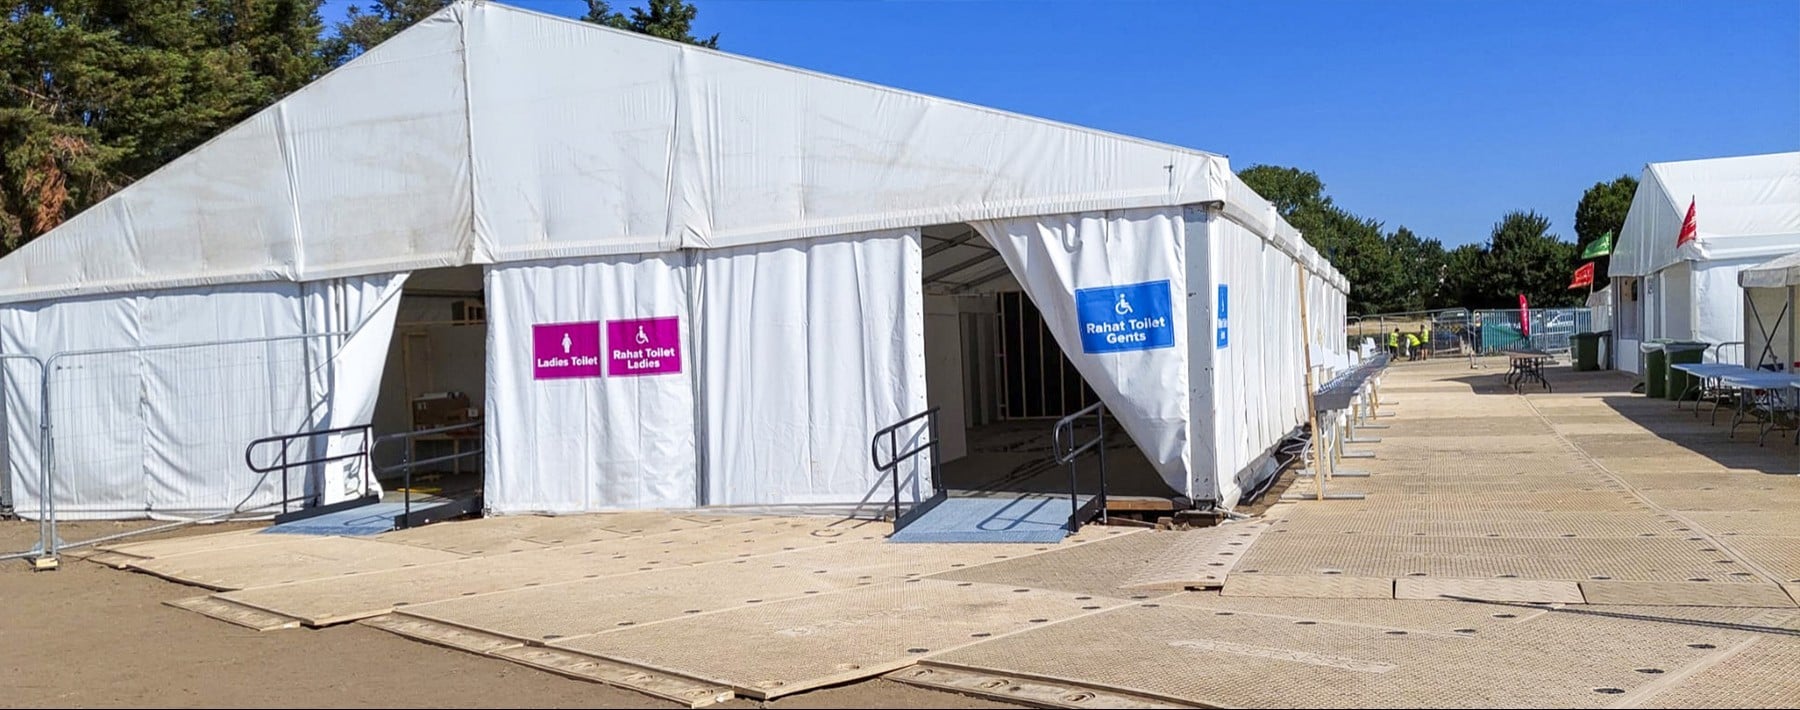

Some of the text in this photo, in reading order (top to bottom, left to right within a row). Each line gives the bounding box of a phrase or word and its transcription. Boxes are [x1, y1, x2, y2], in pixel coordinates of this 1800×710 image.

[1086, 316, 1166, 334] Rahat Toilet
[1106, 332, 1147, 344] Gents
[613, 347, 676, 360] Rahat Toilet
[537, 355, 598, 368] Ladies Toilet
[627, 358, 660, 369] Ladies
